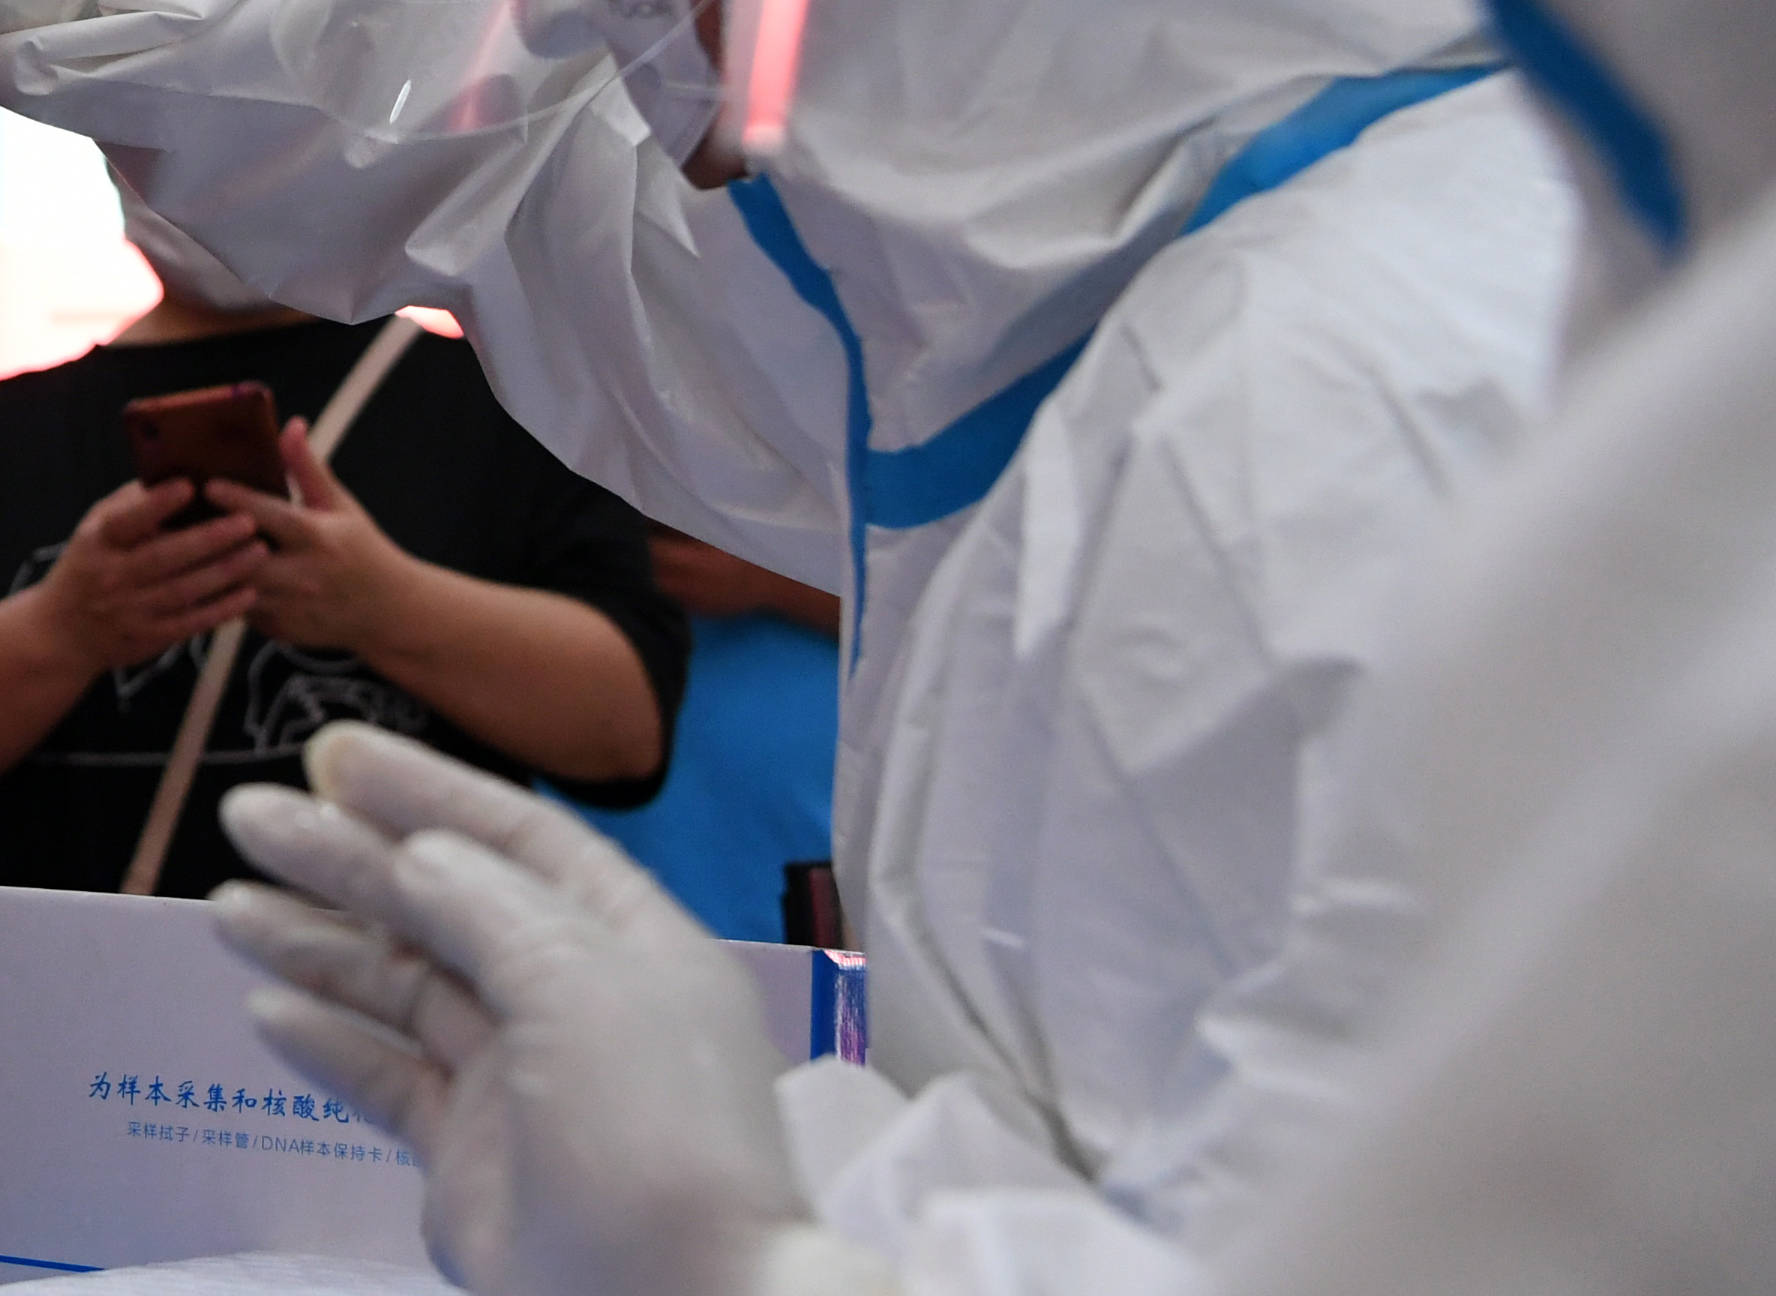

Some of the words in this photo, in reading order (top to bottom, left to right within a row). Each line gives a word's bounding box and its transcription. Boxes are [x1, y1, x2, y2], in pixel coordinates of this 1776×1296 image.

[88, 1070, 374, 1124] 为样本采集和核酸纯
